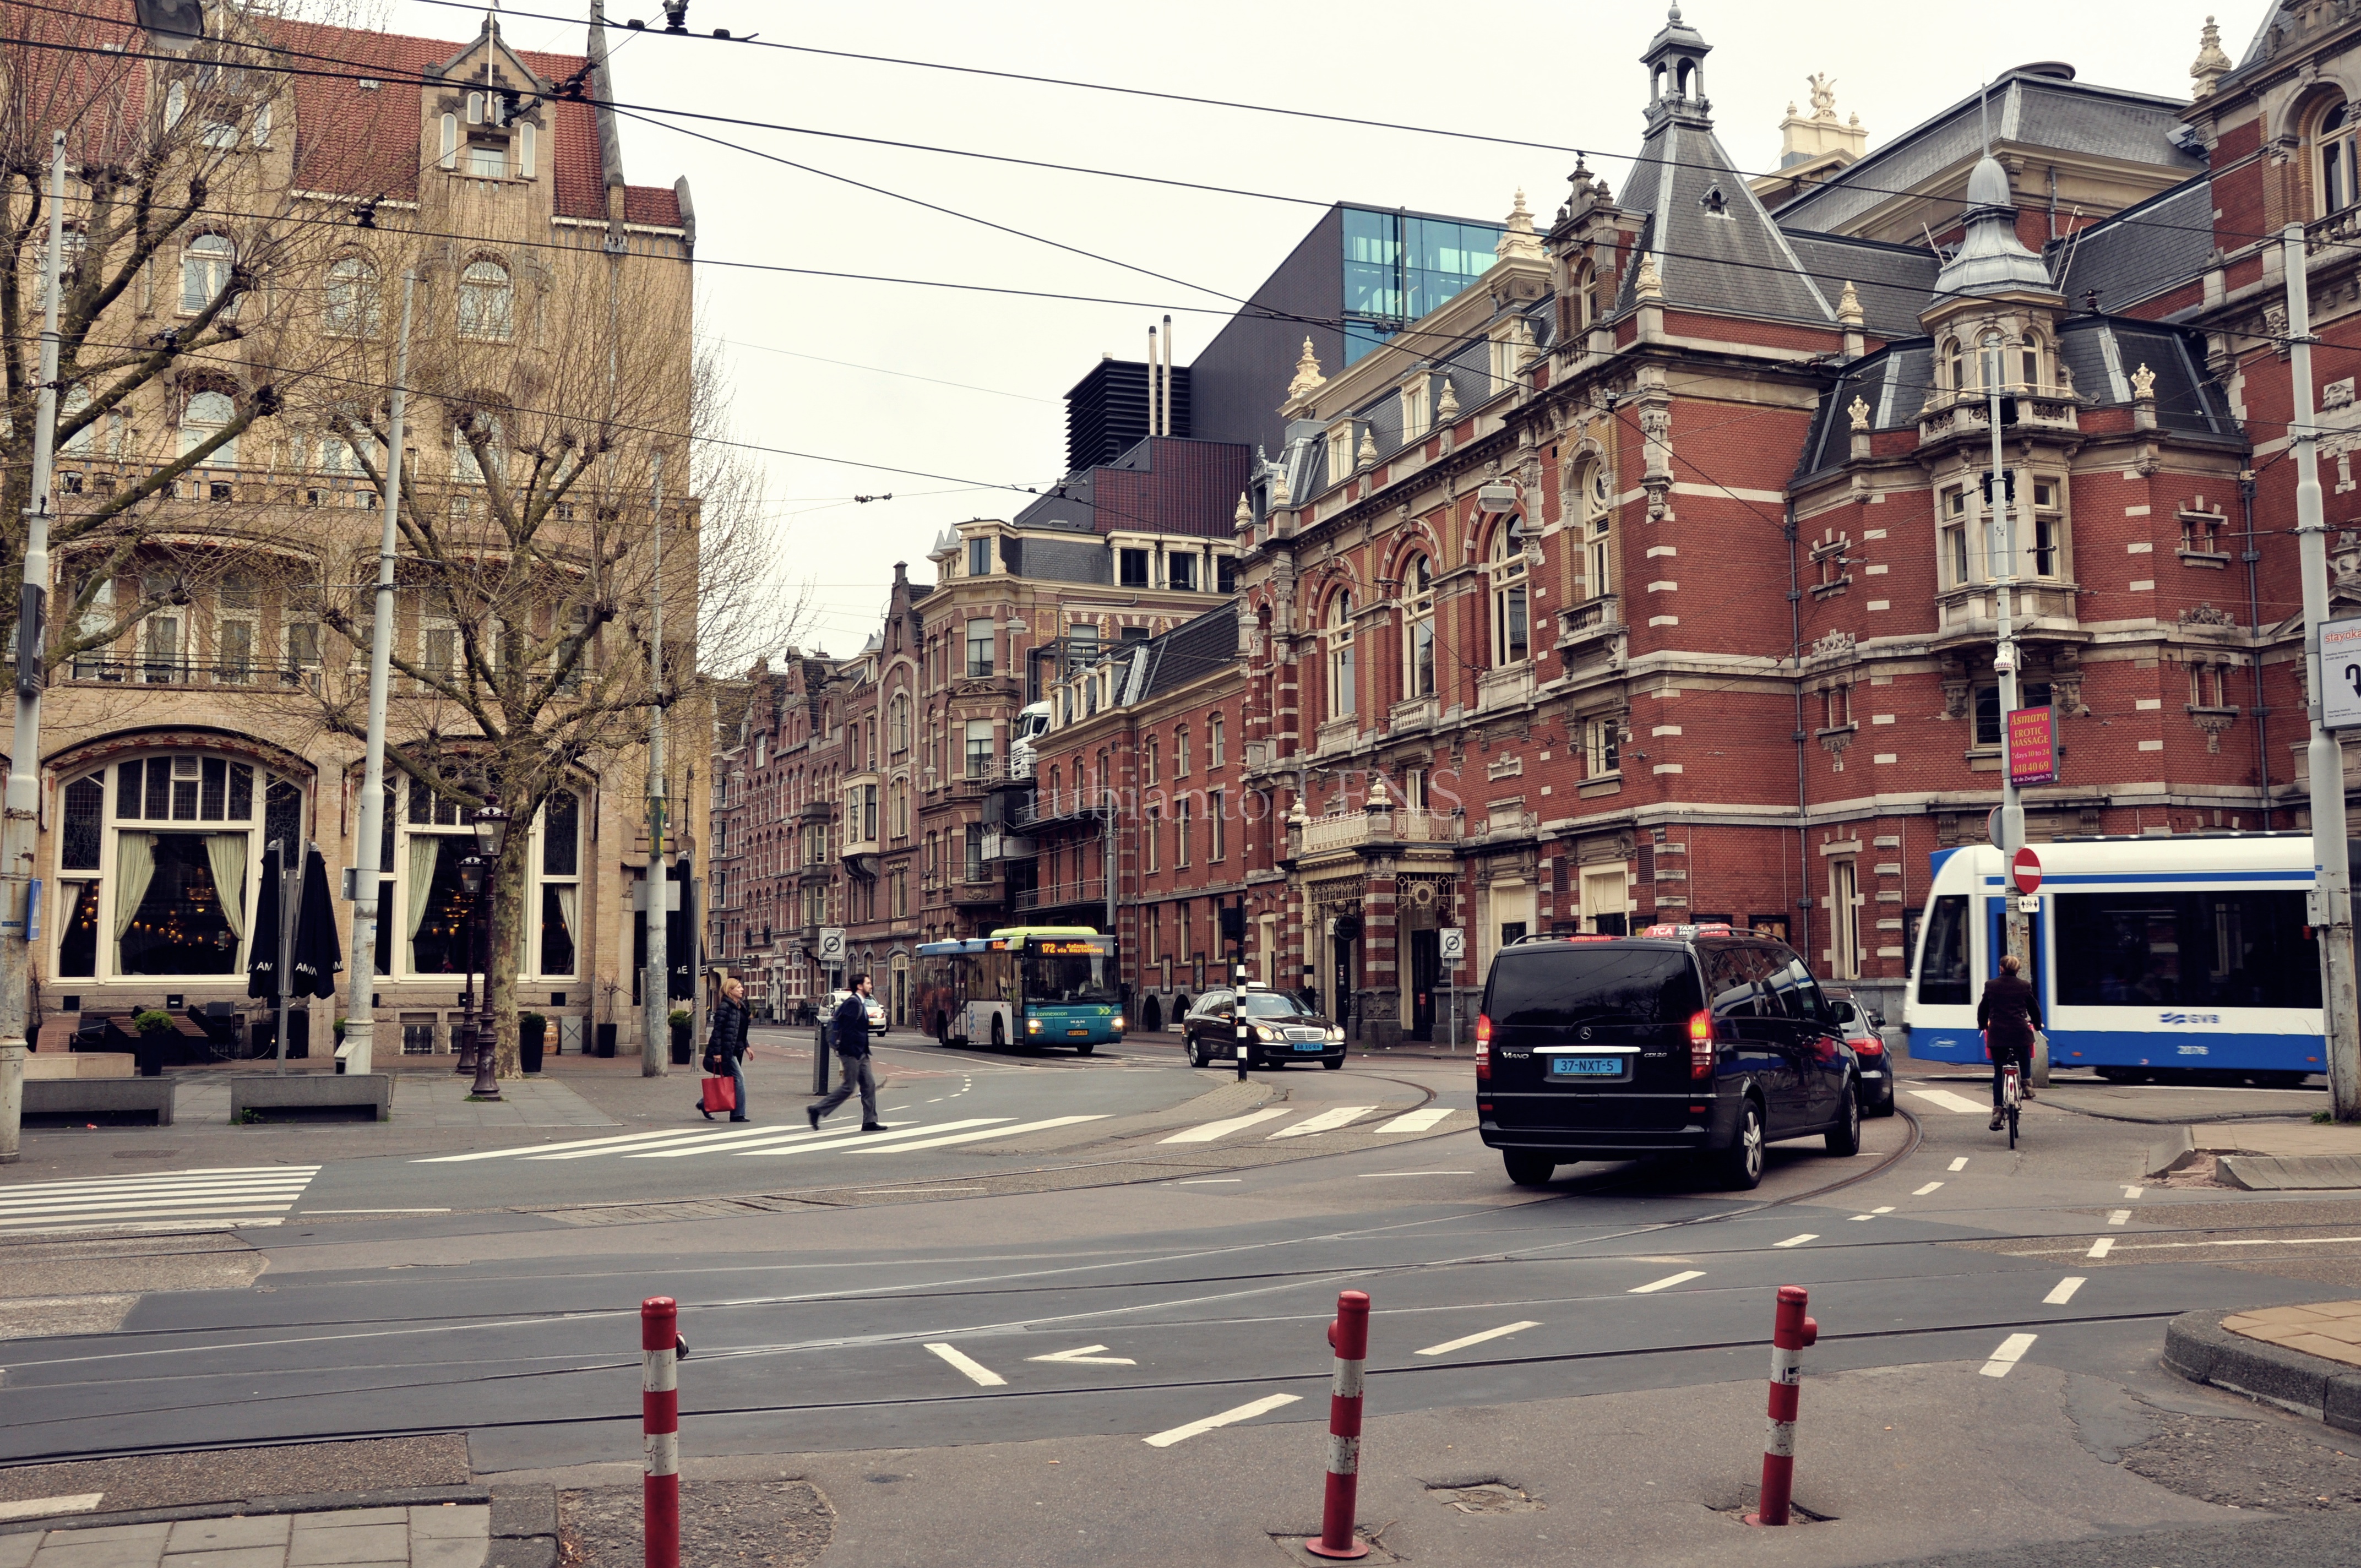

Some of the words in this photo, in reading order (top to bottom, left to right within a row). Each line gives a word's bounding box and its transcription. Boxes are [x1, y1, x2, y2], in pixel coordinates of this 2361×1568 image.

[2010, 712, 2048, 726] Asmara
[2014, 726, 2044, 738] EROTIC
[2011, 735, 2049, 748] MASSAGE
[2014, 763, 2027, 774] 618
[2028, 762, 2038, 772] 40
[2039, 760, 2049, 770] 69
[1042, 943, 1056, 953] 172
[1560, 1060, 1614, 1071] 37-NXT-5
